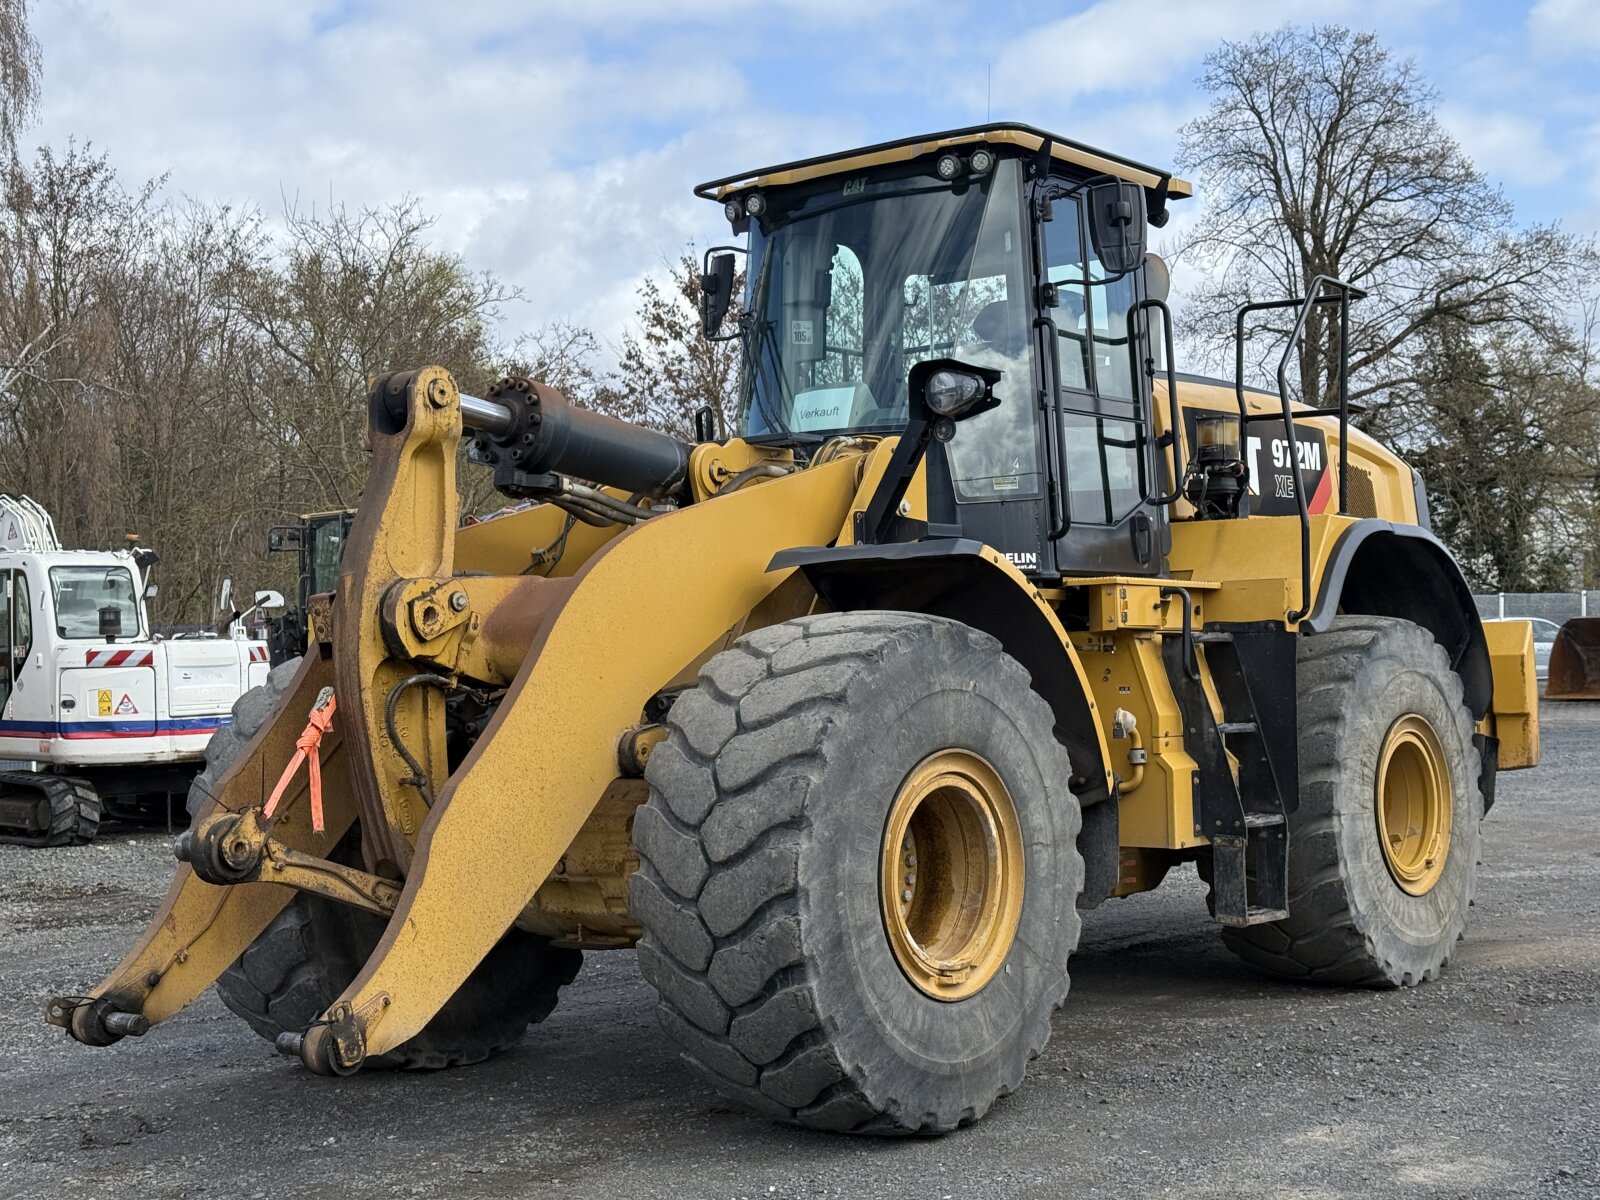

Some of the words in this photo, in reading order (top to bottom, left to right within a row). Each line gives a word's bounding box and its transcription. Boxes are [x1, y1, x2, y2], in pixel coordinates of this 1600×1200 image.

[842, 176, 868, 196] CAT
[799, 406, 840, 420] Verkauft
[1271, 438, 1321, 471] 972M
[1274, 474, 1295, 499] XE
[1004, 552, 1037, 564] ELIN
